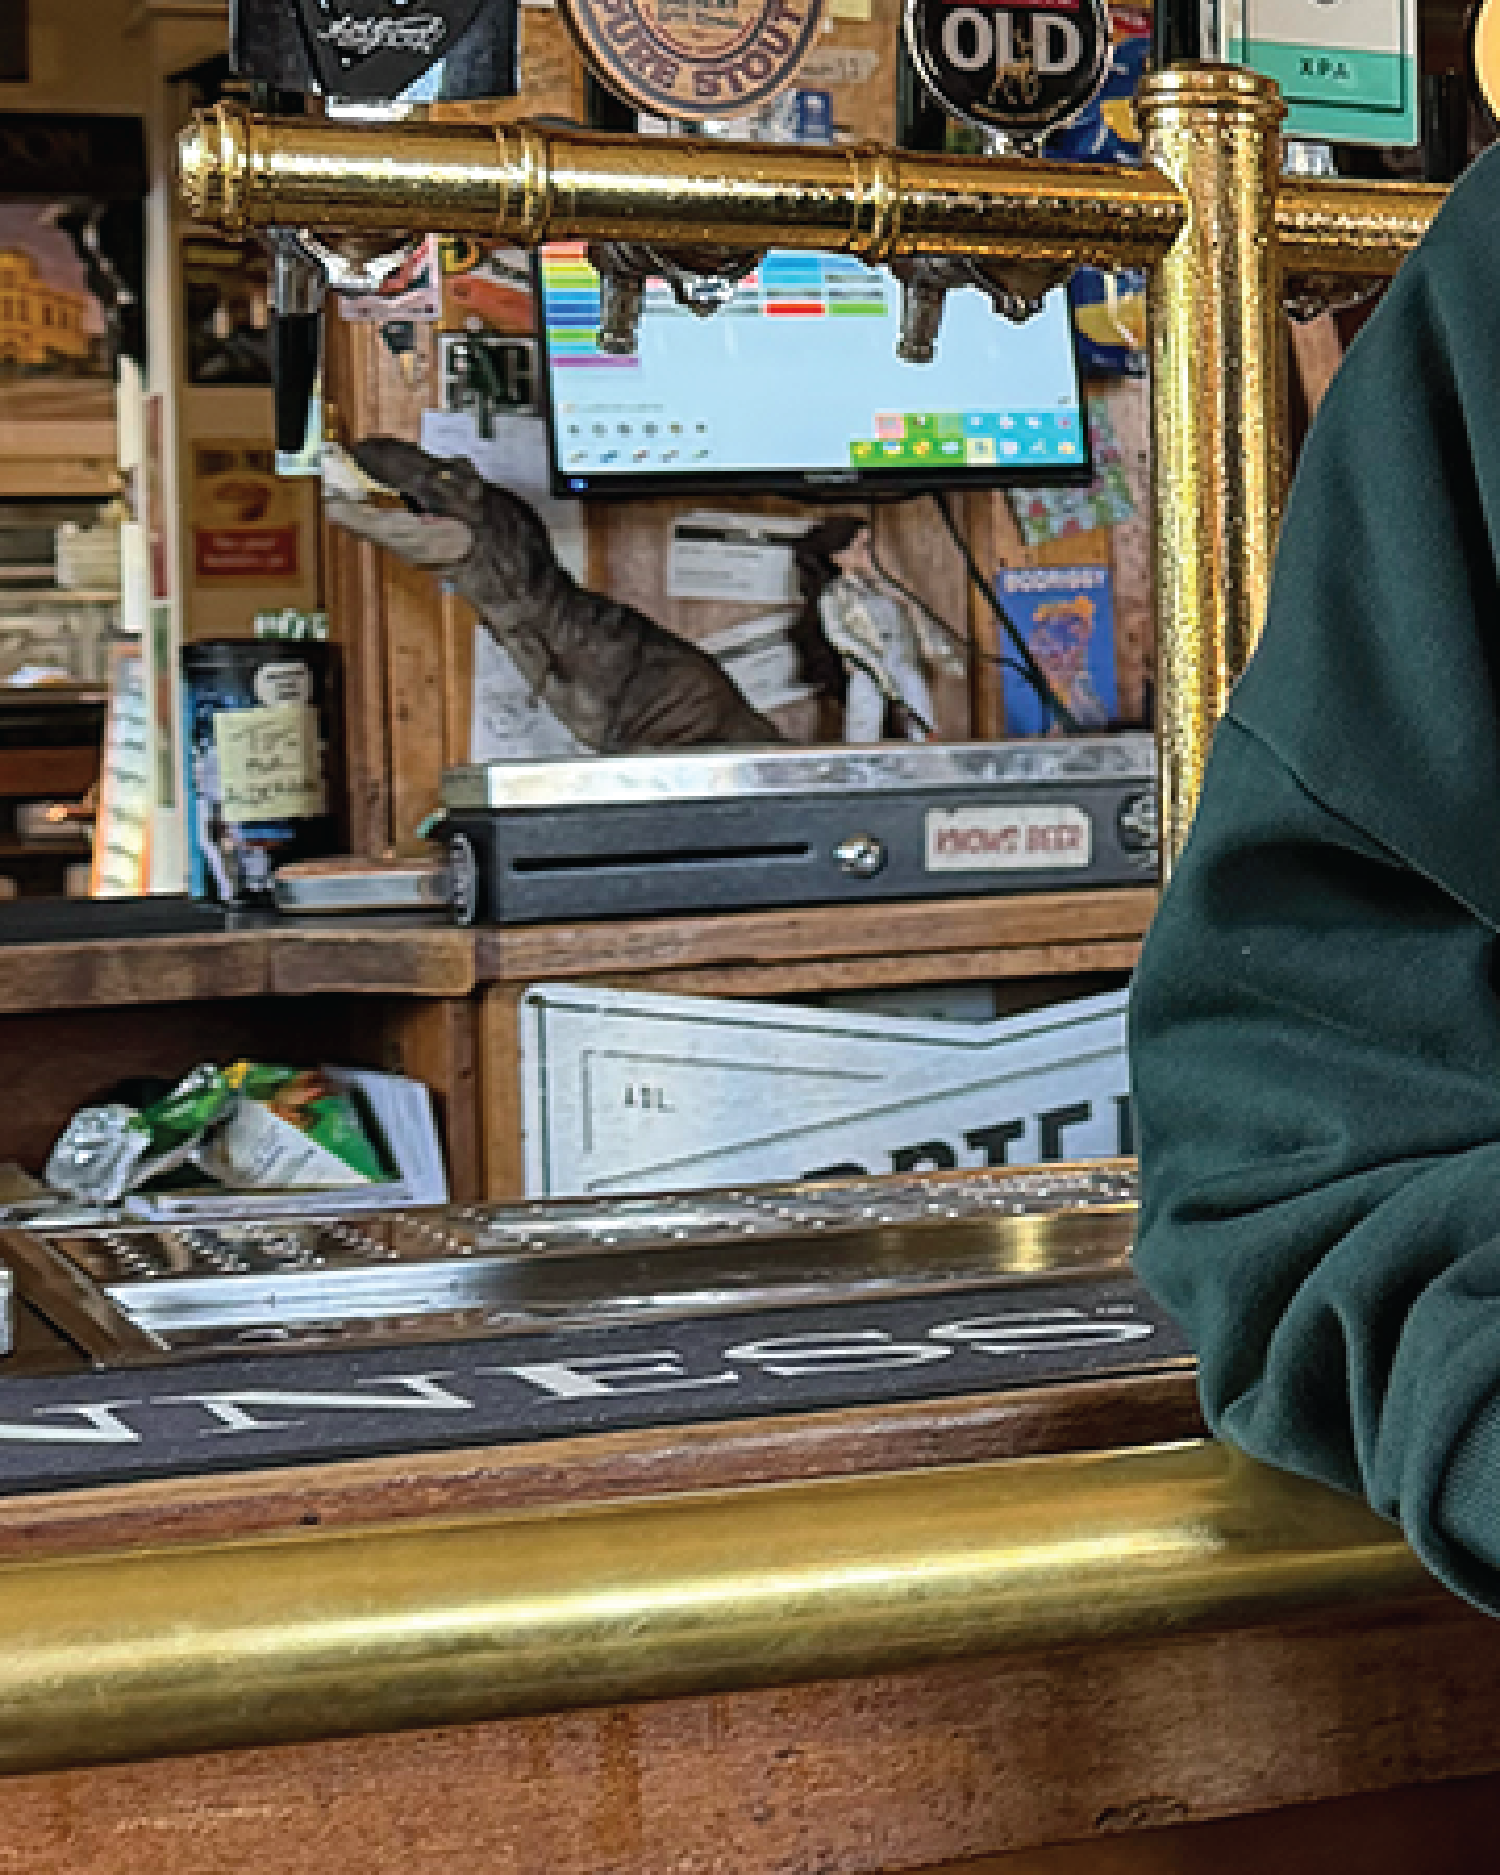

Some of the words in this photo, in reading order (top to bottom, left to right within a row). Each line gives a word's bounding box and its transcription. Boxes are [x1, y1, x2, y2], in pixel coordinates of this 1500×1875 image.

[692, 0, 803, 98] STOUT
[940, 6, 1082, 74] OLD
[1299, 55, 1350, 80] XPA
